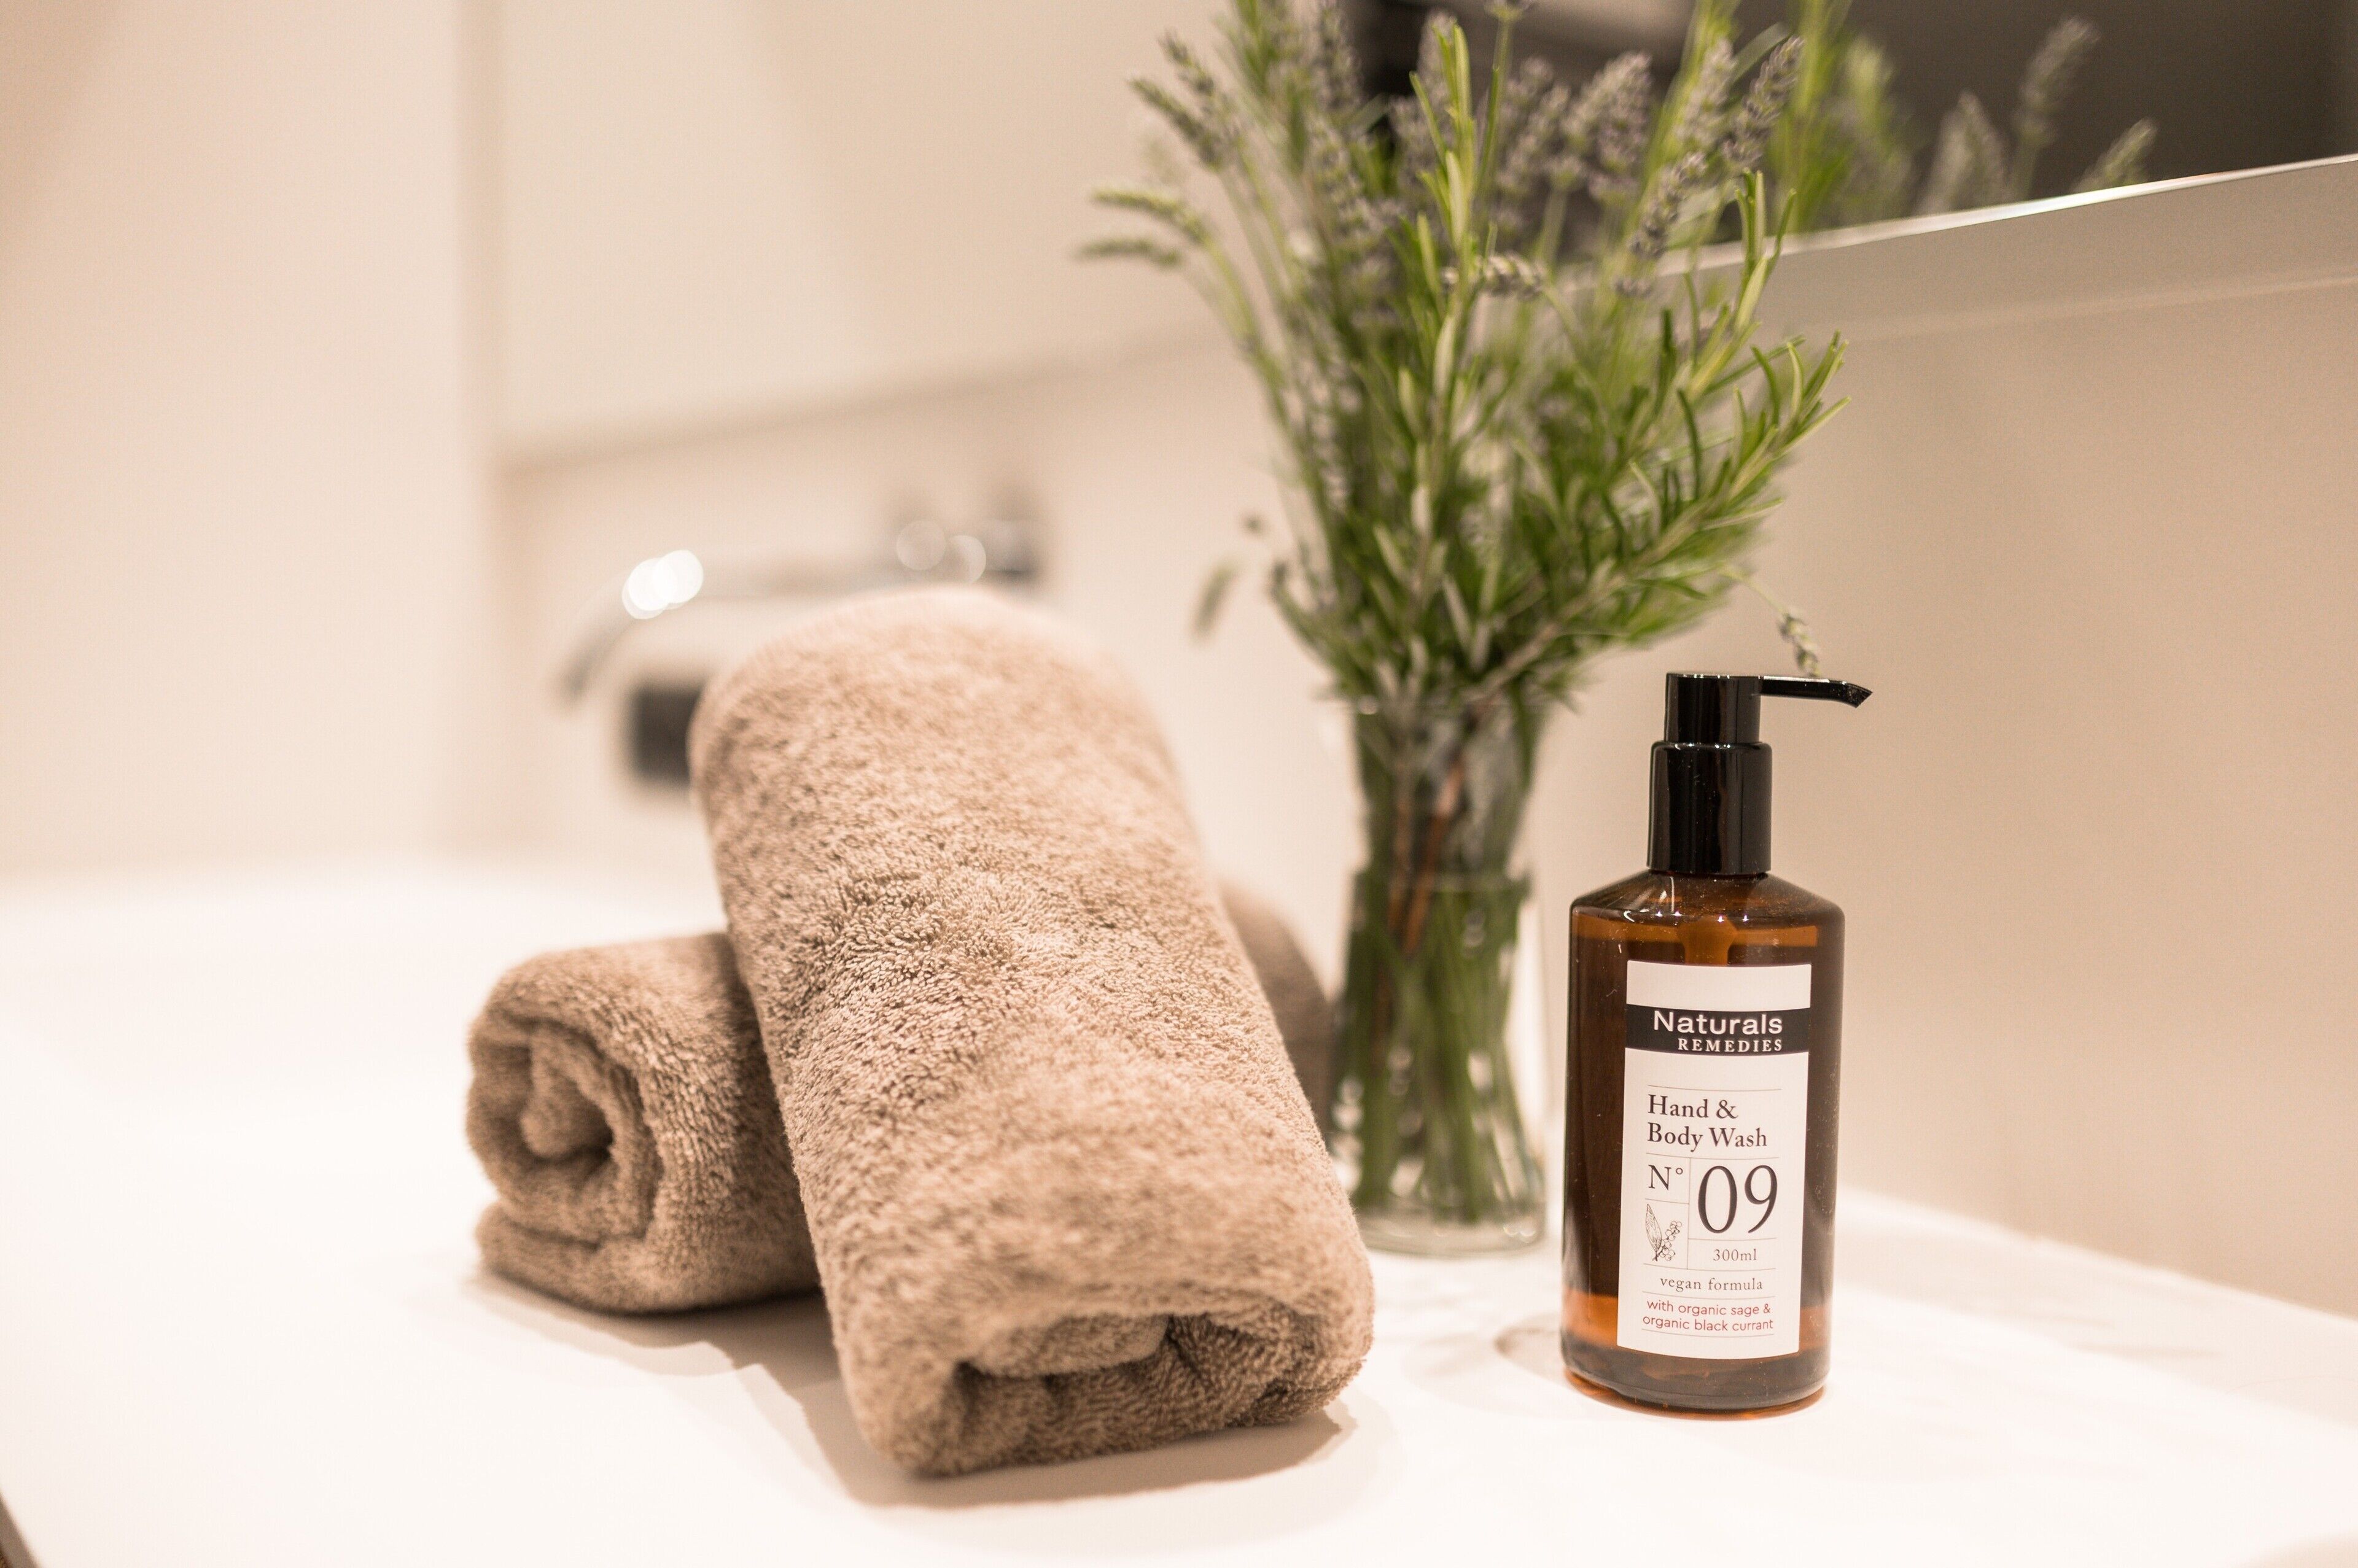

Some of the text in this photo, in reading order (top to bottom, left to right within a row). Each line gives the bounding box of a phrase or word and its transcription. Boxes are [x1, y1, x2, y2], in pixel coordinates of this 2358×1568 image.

[1654, 1011, 1783, 1035] Naturals
[1678, 1038, 1782, 1052] REMEDIES
[1648, 1094, 1738, 1119] Hand &
[1648, 1122, 1767, 1152] Body Wash
[1698, 1165, 1778, 1233] 09
[1713, 1249, 1757, 1261] 300ml
[1660, 1278, 1762, 1292] vegan formula
[1647, 1300, 1770, 1317] with organic sage &
[1643, 1316, 1773, 1331] organic black currant
